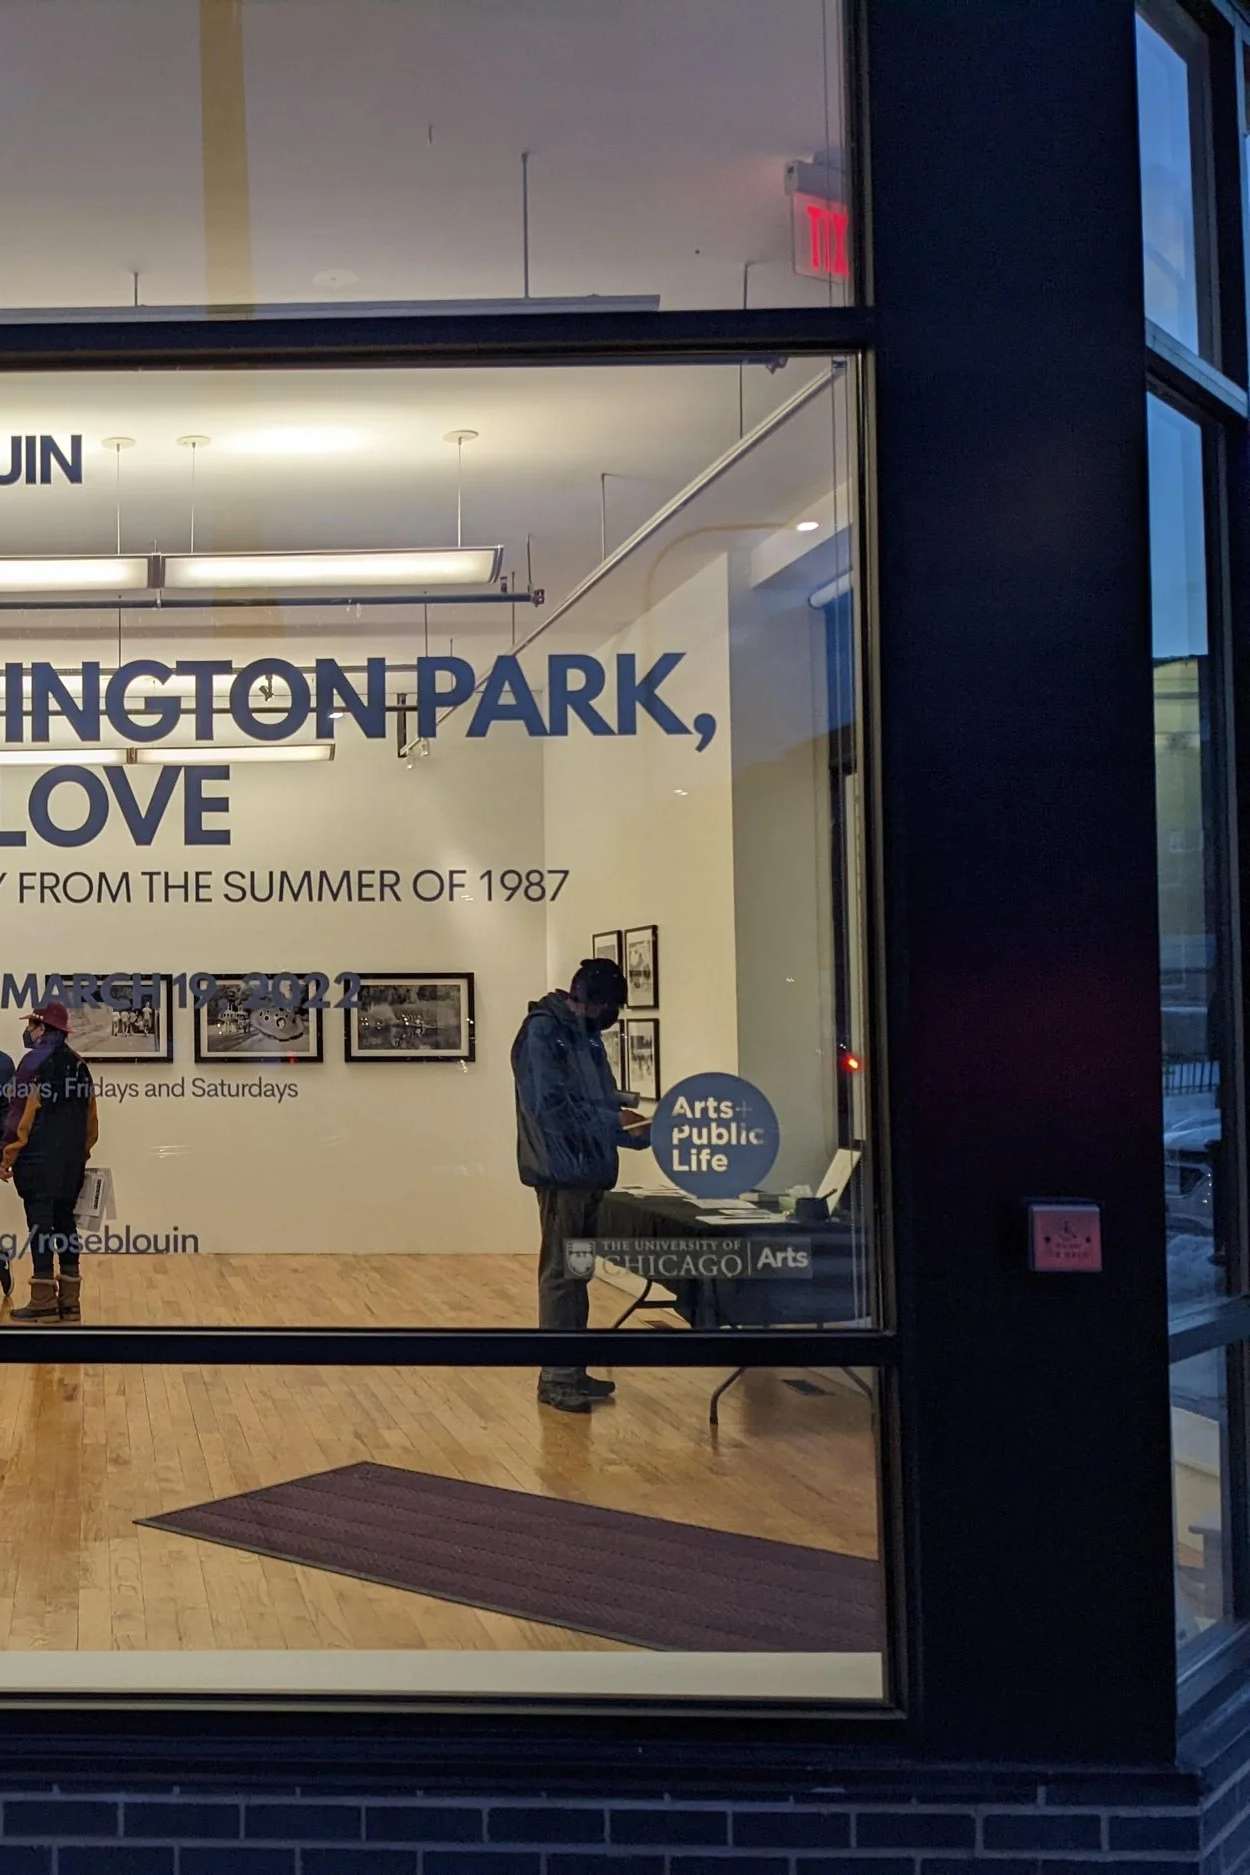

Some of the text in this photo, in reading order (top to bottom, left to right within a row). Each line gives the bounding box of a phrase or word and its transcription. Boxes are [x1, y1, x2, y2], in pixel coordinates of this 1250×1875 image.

[417, 652, 717, 753] PARK,
[19, 871, 132, 904] FROM
[140, 871, 213, 903] THE
[222, 870, 402, 902] SUMMER
[412, 869, 467, 902] OF
[479, 868, 570, 902] 1987
[0, 972, 161, 1009] MARCH
[242, 971, 361, 1009] 2022
[64, 1077, 139, 1103] Fridays
[145, 1077, 185, 1097] and
[191, 1077, 299, 1103] Saturdays
[672, 1121, 764, 1145] Public
[672, 1149, 728, 1172] Life
[603, 1240, 741, 1251] THE UNIVERSITY OF
[602, 1254, 742, 1278] CHICAGO
[757, 1246, 809, 1270] Arts
